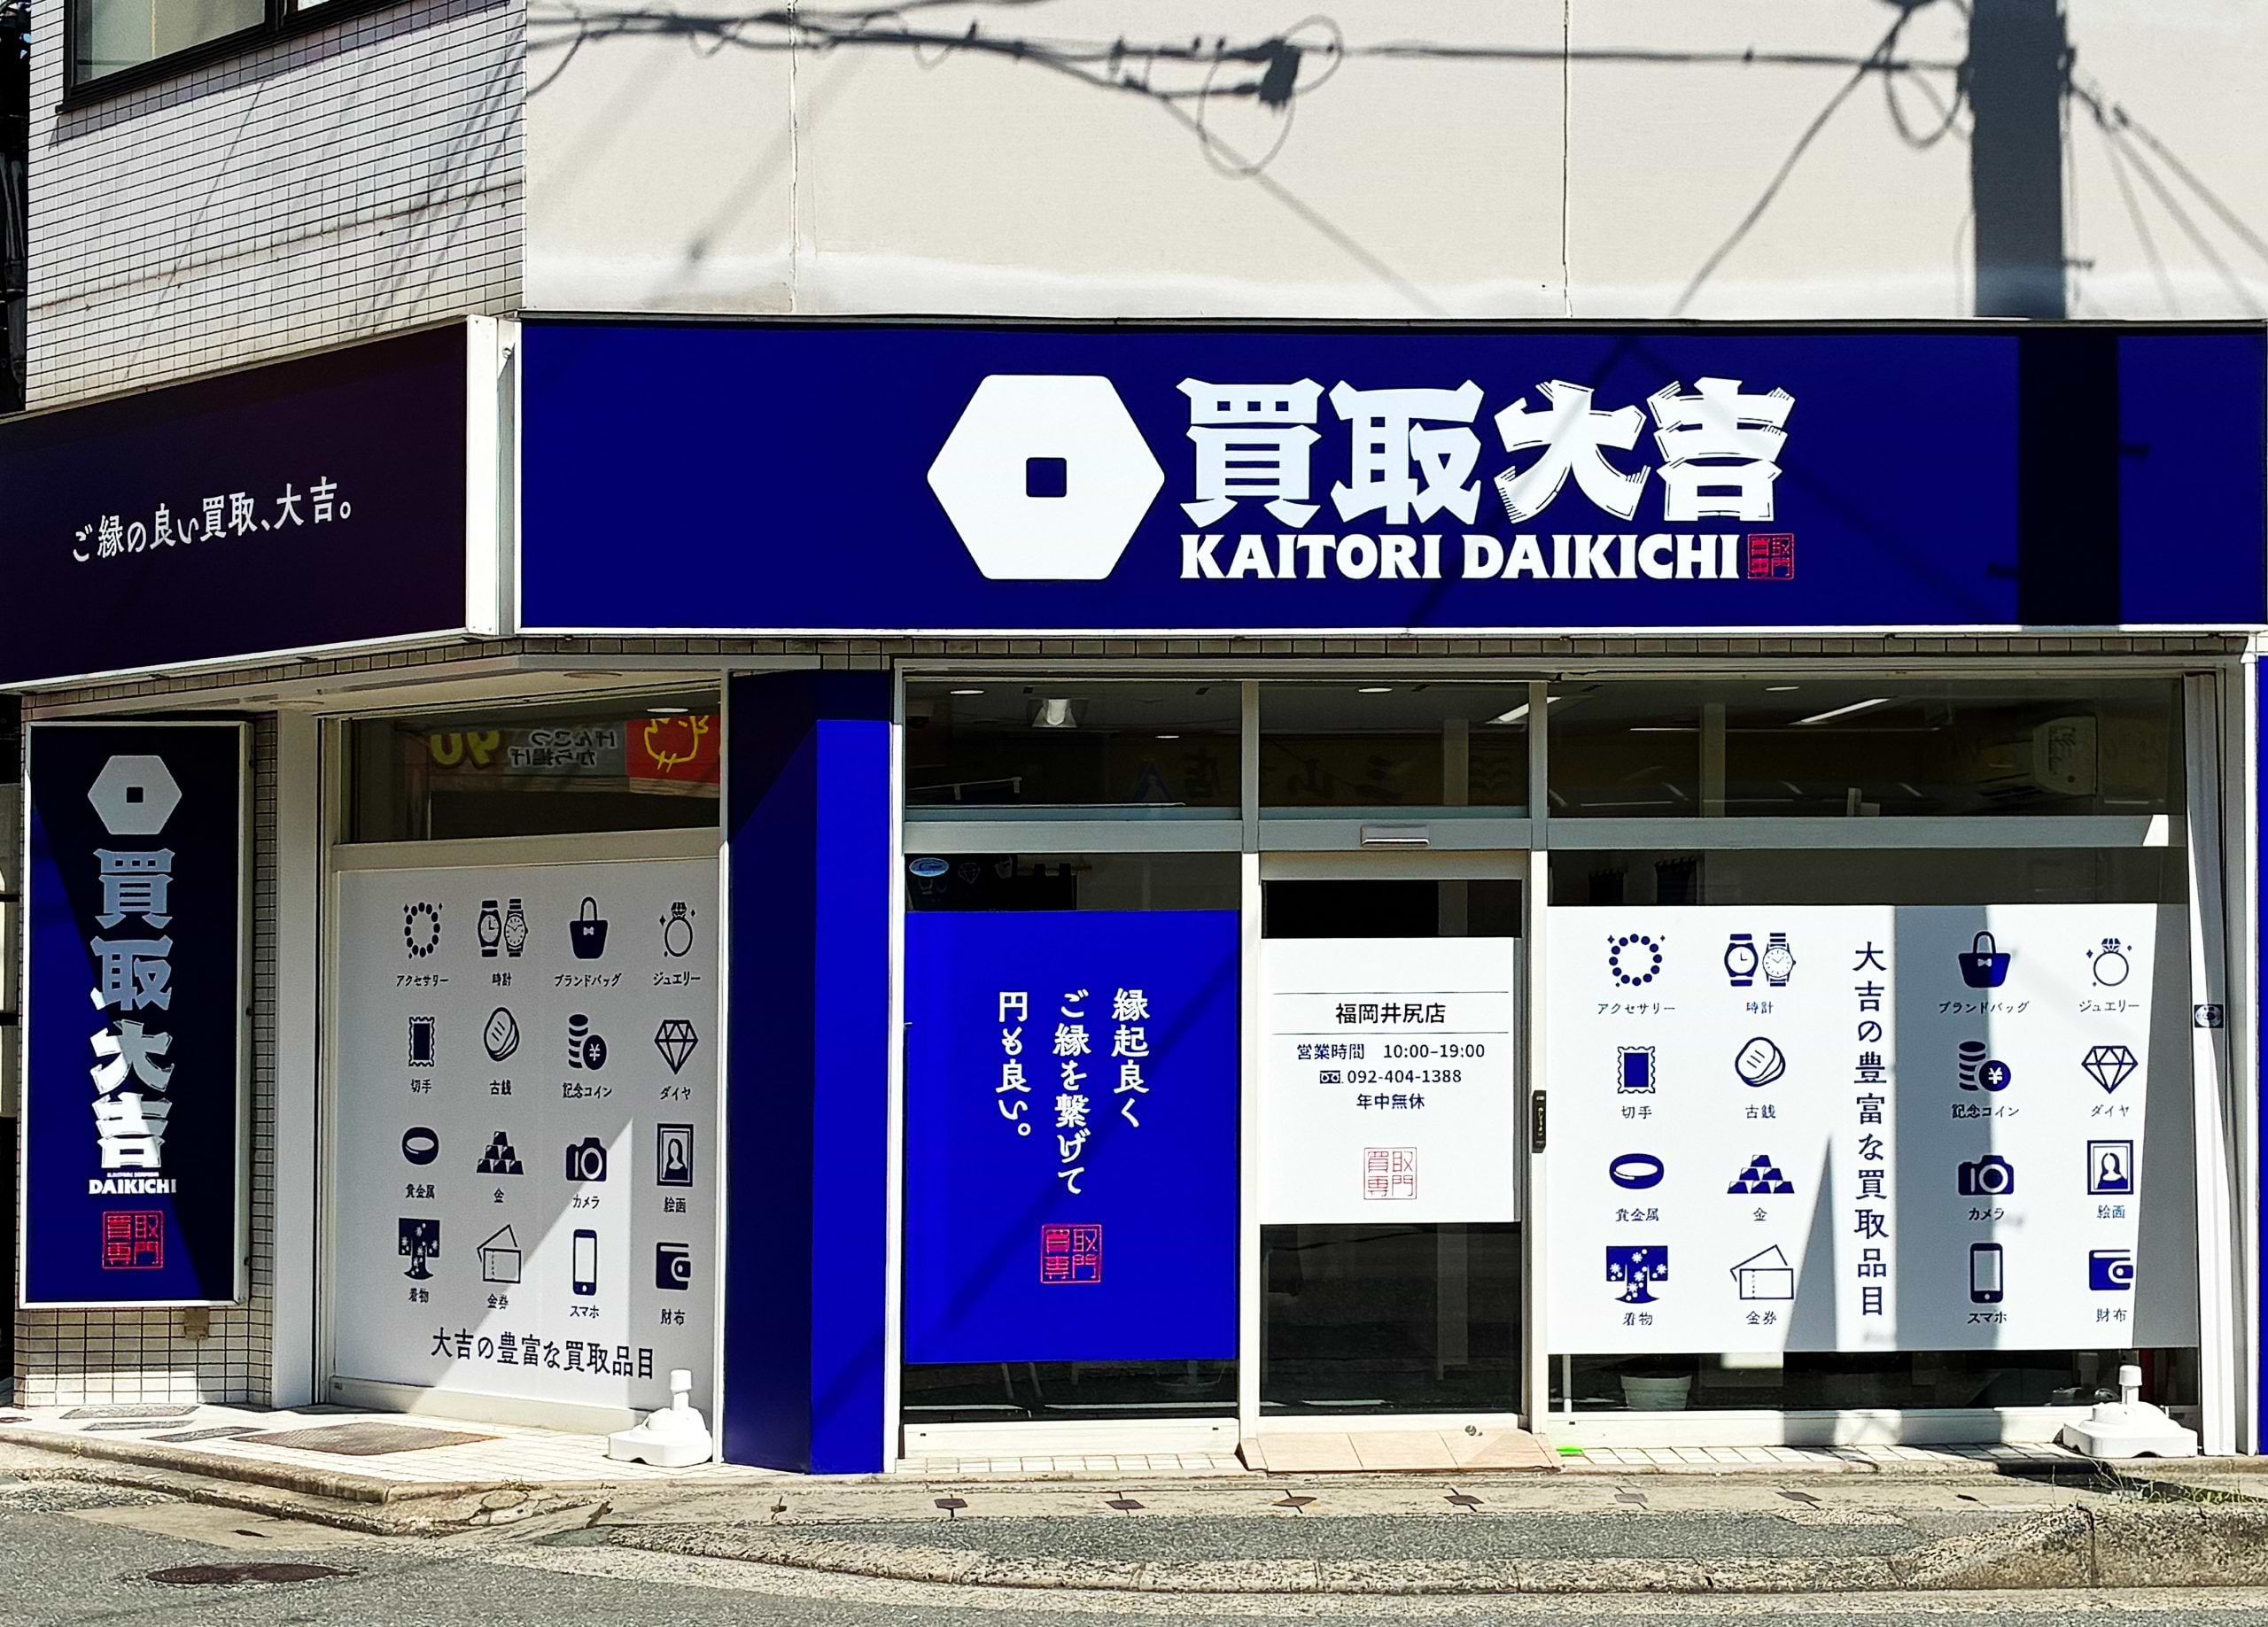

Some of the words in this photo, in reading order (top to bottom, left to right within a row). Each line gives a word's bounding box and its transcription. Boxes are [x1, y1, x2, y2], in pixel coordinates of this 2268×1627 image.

[1176, 376, 1796, 529] 買取大吉
[73, 476, 352, 562] ご縁の良い買取、大吉。
[1179, 533, 1443, 580] KAITORI
[1461, 533, 1740, 580] DAIKICHI
[396, 973, 449, 988] アクセサリー
[554, 972, 623, 988] ブランドバッグ
[653, 970, 701, 987] ジュエリー
[89, 848, 175, 1169] 買取大吉
[1335, 1002, 1447, 1025] 福岡井尻店
[1597, 1002, 1675, 1015] アクセサリー
[1938, 1001, 2030, 1014] ブランドバッグ
[2078, 999, 2140, 1012] ジュエリー
[1110, 988, 1151, 1127] 縁起良く
[1296, 1042, 1364, 1060] 営業時間
[995, 991, 1032, 1136] 円も良い。
[1347, 1069, 1462, 1084] 092-404-1388
[410, 1078, 432, 1095] 切手
[562, 1081, 613, 1099] 記念コイン
[659, 1085, 691, 1102] ダイヤ
[1052, 988, 1092, 1195] ご縁を繋げて
[1355, 1092, 1425, 1111] 年中無休
[1620, 1105, 1652, 1120] 切手
[1952, 1104, 2020, 1120] 記念コイン
[2090, 1104, 2130, 1118] ダイヤ
[1852, 941, 1890, 1316] 大吉の豊富な買取品目
[1368, 1151, 1413, 1173] 買取
[88, 1178, 177, 1195] DAIKICHI
[493, 1187, 505, 1204] 金
[572, 1193, 600, 1210] カメラ
[1752, 1206, 1767, 1222] 金
[1968, 1206, 2006, 1222] カメラ
[2096, 1204, 2126, 1220] 絵画
[569, 1305, 600, 1320] スマホ
[660, 1308, 686, 1327] 財布
[1966, 1311, 2008, 1326] スマホ
[2094, 1305, 2129, 1325] 財布
[431, 1327, 653, 1380] 大吉の豊富な買取品目
